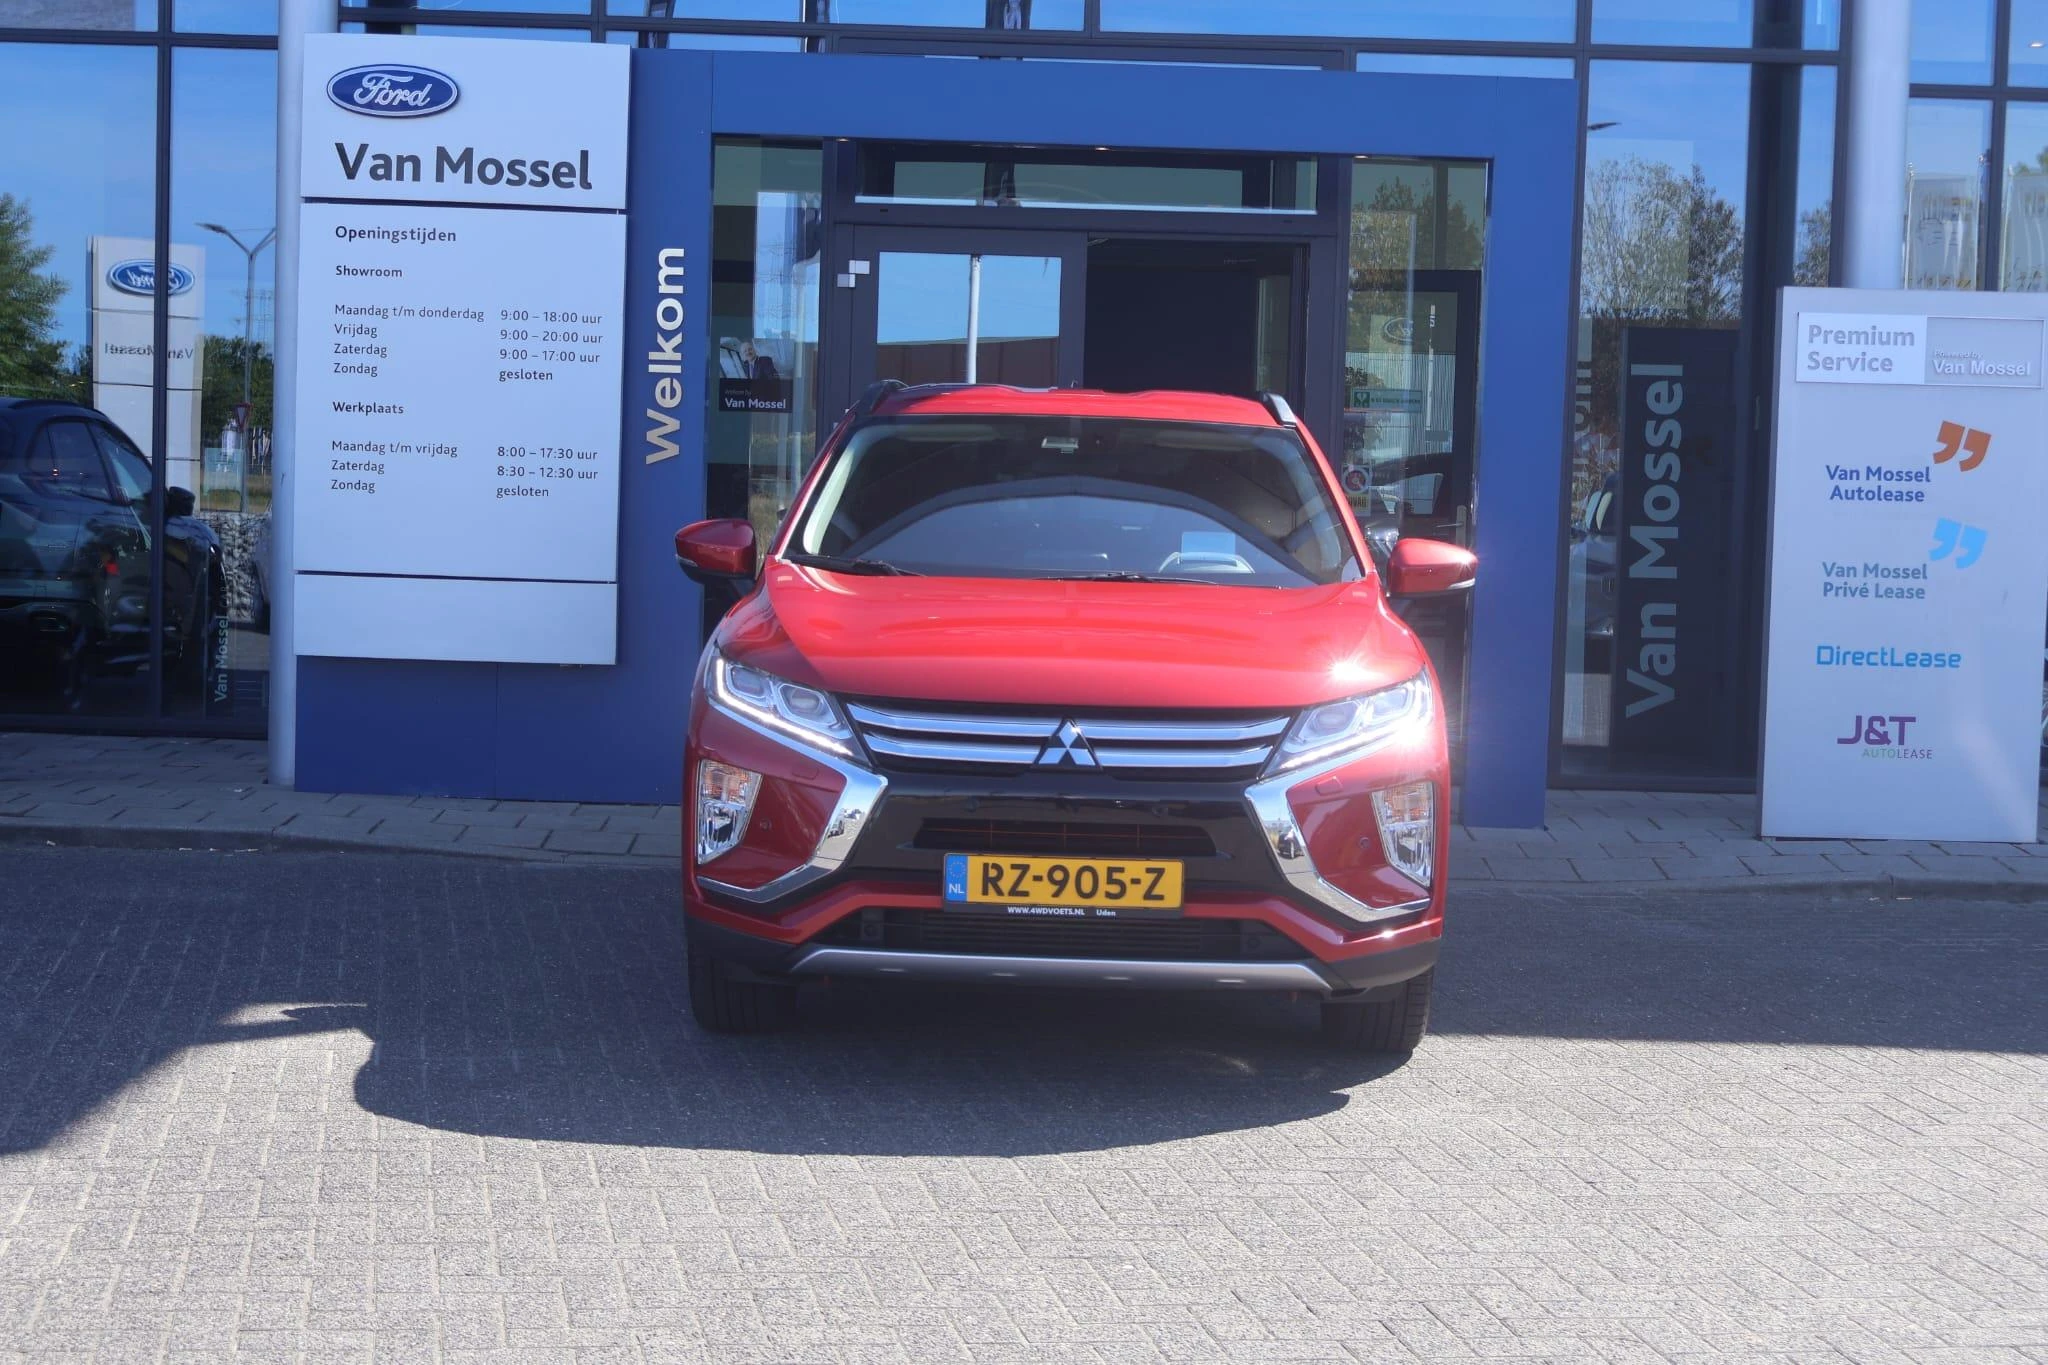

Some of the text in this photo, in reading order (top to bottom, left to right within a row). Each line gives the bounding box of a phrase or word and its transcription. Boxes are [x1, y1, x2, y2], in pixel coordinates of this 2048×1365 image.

[353, 73, 432, 106] Ford
[335, 142, 592, 190] Van Mossel
[335, 225, 457, 243] Openingstijden
[335, 265, 403, 278] Showroom
[334, 304, 485, 323] Maandag t/m donderdag
[500, 310, 529, 322] 9:00
[543, 311, 578, 323] 18:00
[581, 314, 602, 324] uur
[334, 323, 378, 339] Vrijdag
[500, 329, 529, 342] 9:00
[542, 330, 578, 343] 20:00
[582, 334, 603, 344] uur
[1807, 324, 1915, 347] Premium
[333, 343, 388, 359] Zaterdag
[499, 349, 528, 361] 9:00
[542, 350, 576, 363] 17:00
[579, 353, 600, 364] uur
[645, 248, 685, 465] Welkom
[1807, 351, 1893, 372] Service
[1933, 360, 2031, 376] Van Mossel
[333, 363, 378, 378] Zondag
[499, 368, 553, 382] gesloten
[333, 401, 404, 416] Werkplaats
[725, 398, 786, 409] Van Mossel
[332, 440, 458, 458] Maandag t/m vrijdag
[497, 446, 527, 458] 8:00
[540, 447, 574, 460] 17:30
[577, 450, 598, 461] uur
[331, 460, 385, 475] Zaterdag
[497, 466, 526, 478] 8:30
[539, 467, 574, 479] 12:30
[577, 470, 598, 481] uur
[1826, 465, 1931, 482] Van Mossel
[331, 479, 376, 494] Zondag
[496, 485, 549, 499] gesloten
[1829, 486, 1925, 502] Autolease
[1626, 363, 1684, 718] Van Mossel
[1822, 561, 1928, 580] Van Mossel
[1823, 581, 1926, 599] Privé Lease
[216, 615, 229, 669] Mossel
[1816, 645, 1961, 668] DirectLease
[215, 673, 228, 702] Van
[1837, 715, 1916, 746] J&T
[1862, 749, 1933, 760] AUTOLEASE
[949, 884, 964, 894] NL
[980, 862, 1166, 901] RZ-905-Z
[1007, 906, 1116, 917] WWW.4WDVOETS.NL Uden
